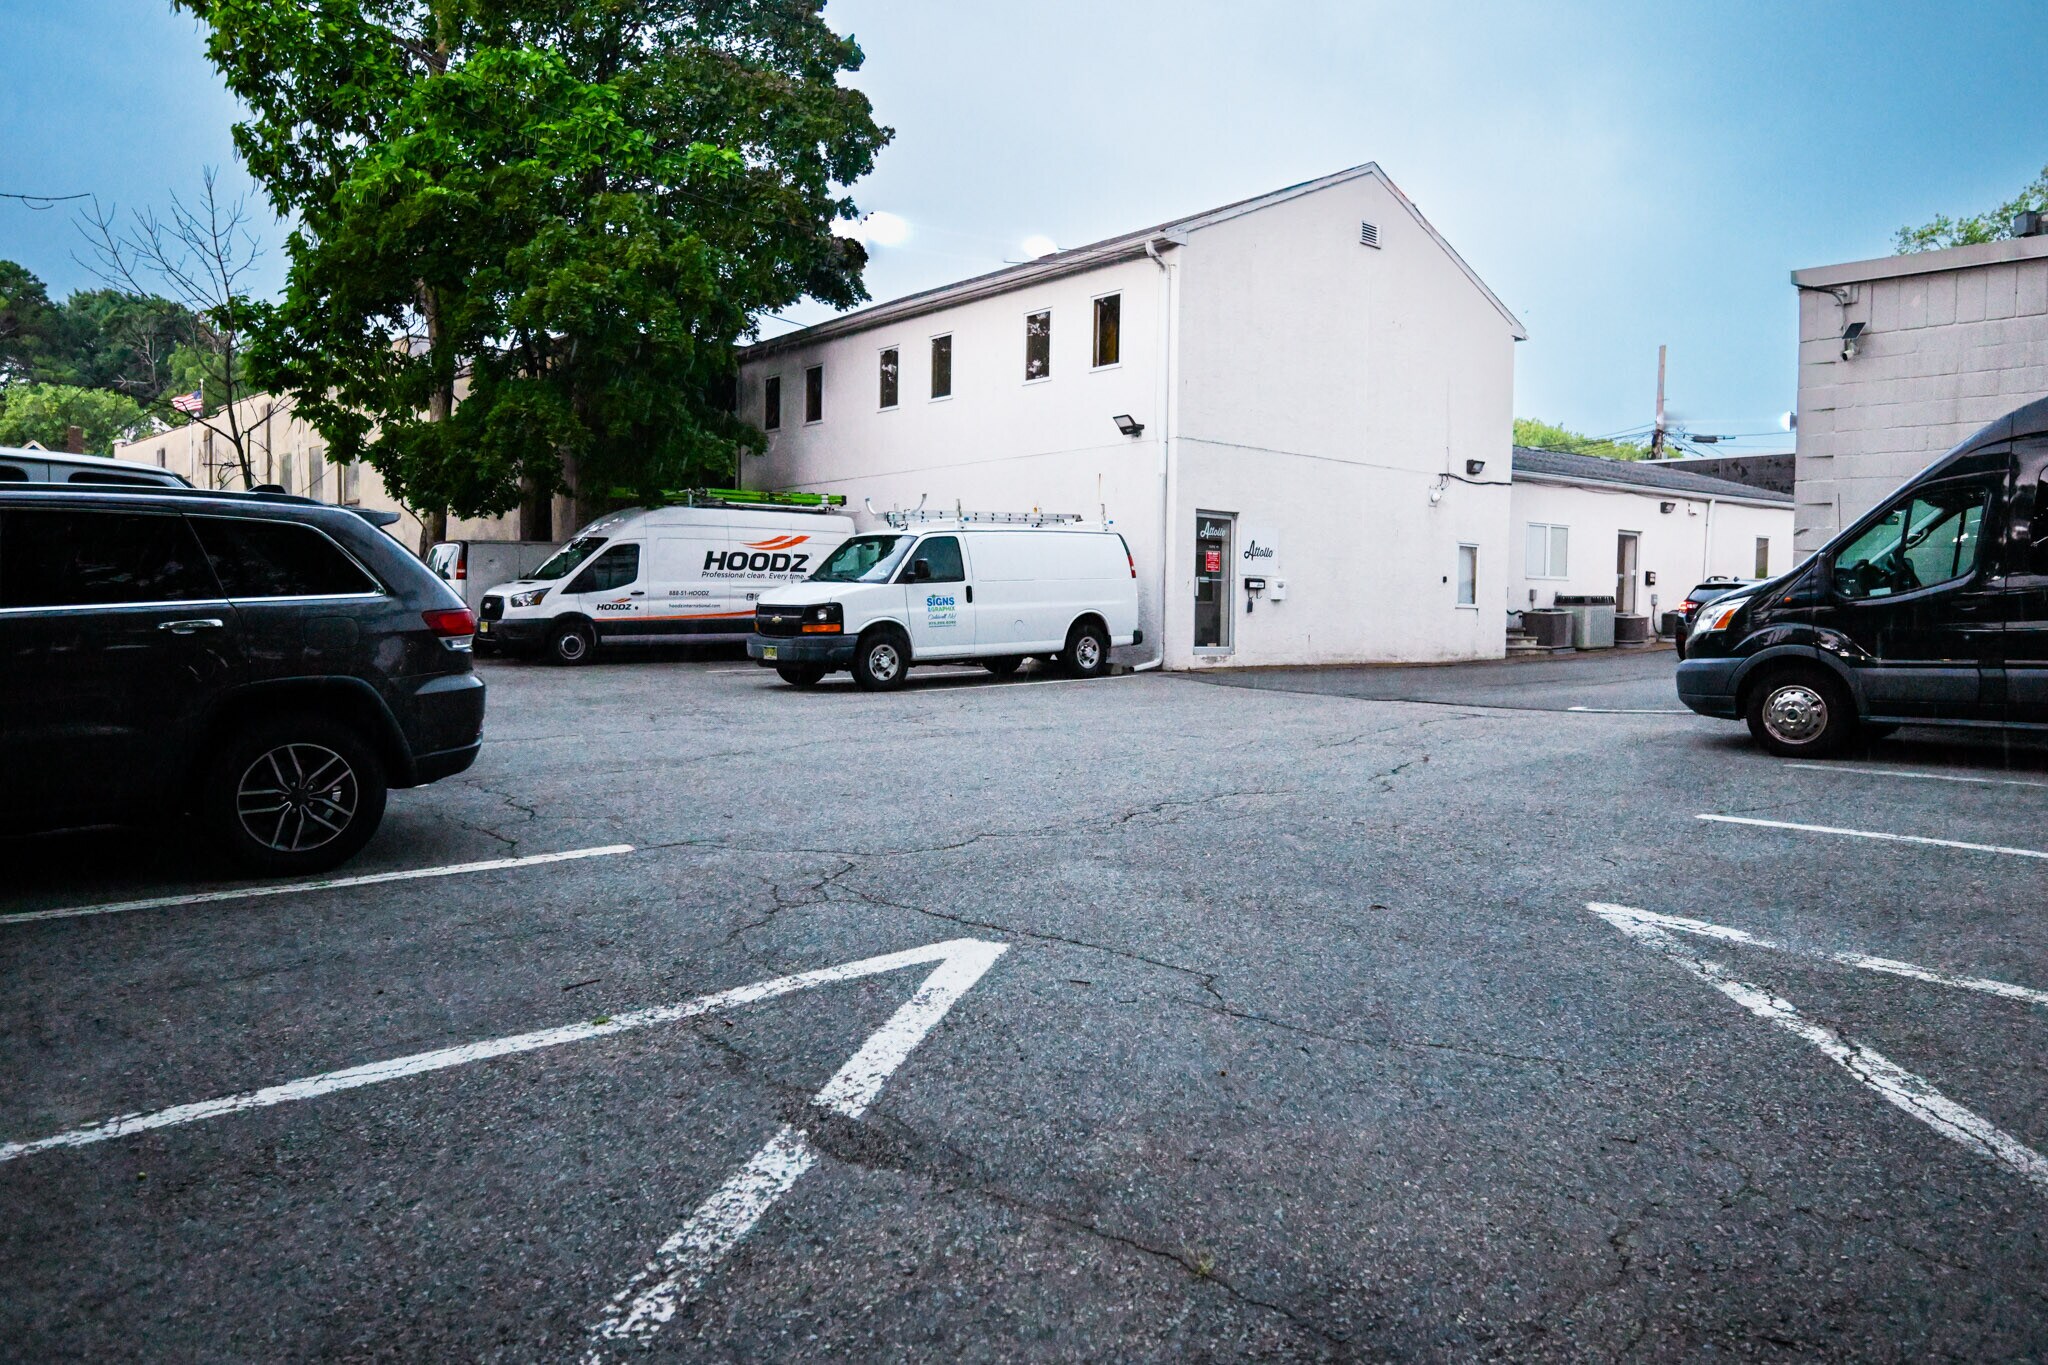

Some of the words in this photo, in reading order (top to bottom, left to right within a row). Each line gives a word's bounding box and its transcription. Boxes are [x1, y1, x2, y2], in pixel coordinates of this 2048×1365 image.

[1244, 540, 1273, 560] Attollo
[703, 551, 810, 572] HOODZ
[701, 571, 745, 579] Professional
[926, 596, 955, 606] SIGNS
